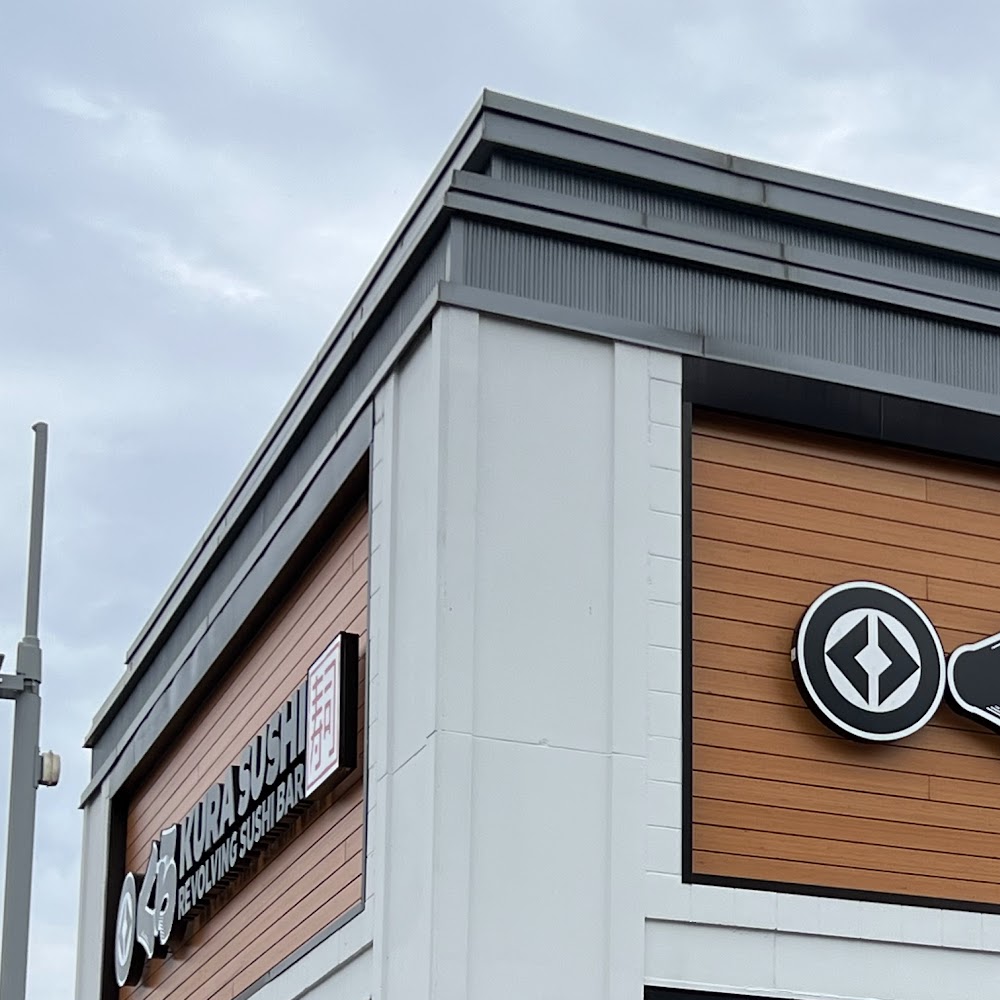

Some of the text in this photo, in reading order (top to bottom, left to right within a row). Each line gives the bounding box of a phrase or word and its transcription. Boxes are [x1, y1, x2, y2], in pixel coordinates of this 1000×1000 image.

[177, 763, 306, 921] REVOLVING SUSHI BAR
[179, 680, 308, 879] KURA SUSHI
